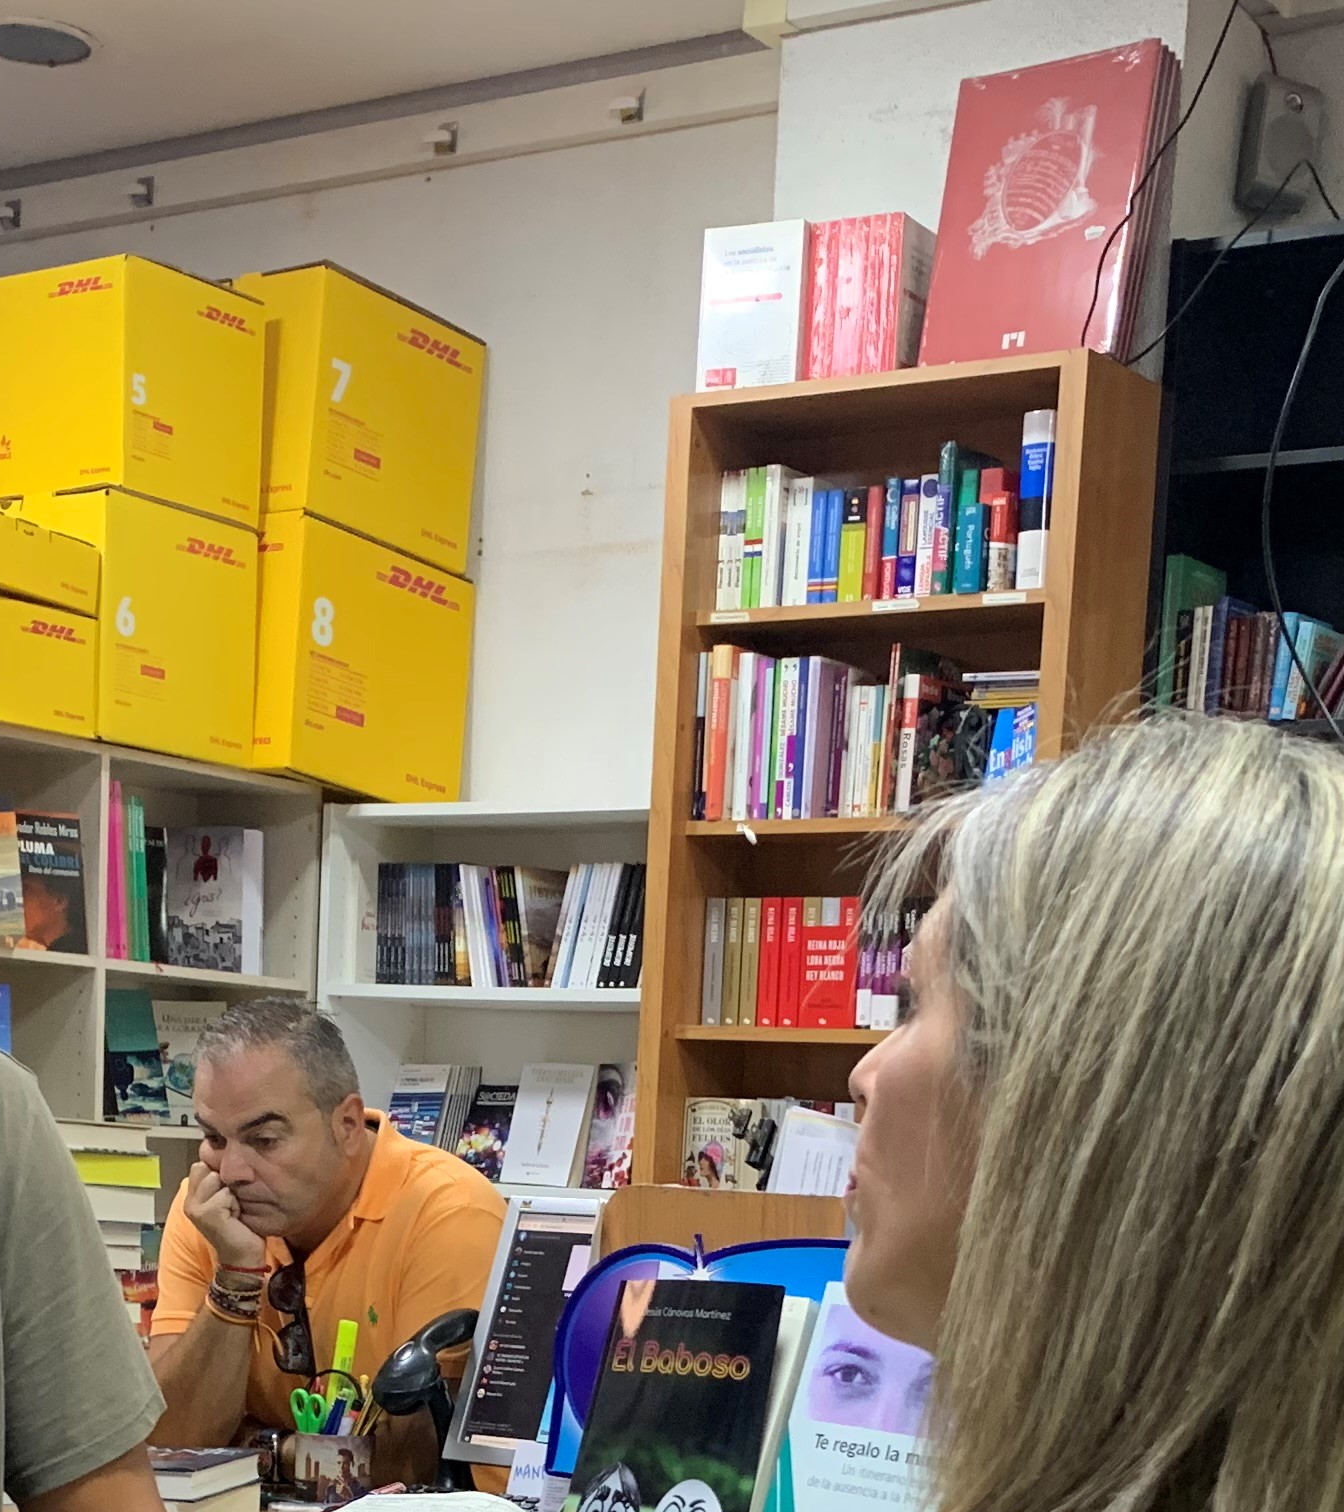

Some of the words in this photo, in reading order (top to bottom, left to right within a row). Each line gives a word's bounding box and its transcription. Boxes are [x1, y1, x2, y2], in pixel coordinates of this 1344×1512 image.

[56, 276, 105, 298] DHL
[204, 305, 251, 334] DHL
[406, 328, 464, 369] DHL
[131, 373, 147, 405] 5
[331, 357, 352, 403] 7
[185, 537, 238, 566] DHL
[387, 564, 450, 607] DHL
[29, 619, 78, 643] DHL
[116, 596, 136, 637] 6
[311, 596, 335, 647] 8
[900, 733, 912, 769] Rosas
[807, 939, 827, 951] REINA
[827, 939, 846, 951] ROJA
[806, 954, 822, 966] LOBA
[693, 1117, 703, 1126] EL
[692, 1133, 732, 1144] FELICES
[695, 1308, 733, 1321] Martínez
[612, 1338, 636, 1373] El
[640, 1338, 751, 1381] Baboso
[815, 1433, 828, 1450] Te
[833, 1438, 881, 1458] regalo
[885, 1444, 900, 1463] la
[832, 1481, 878, 1499] ausencia
